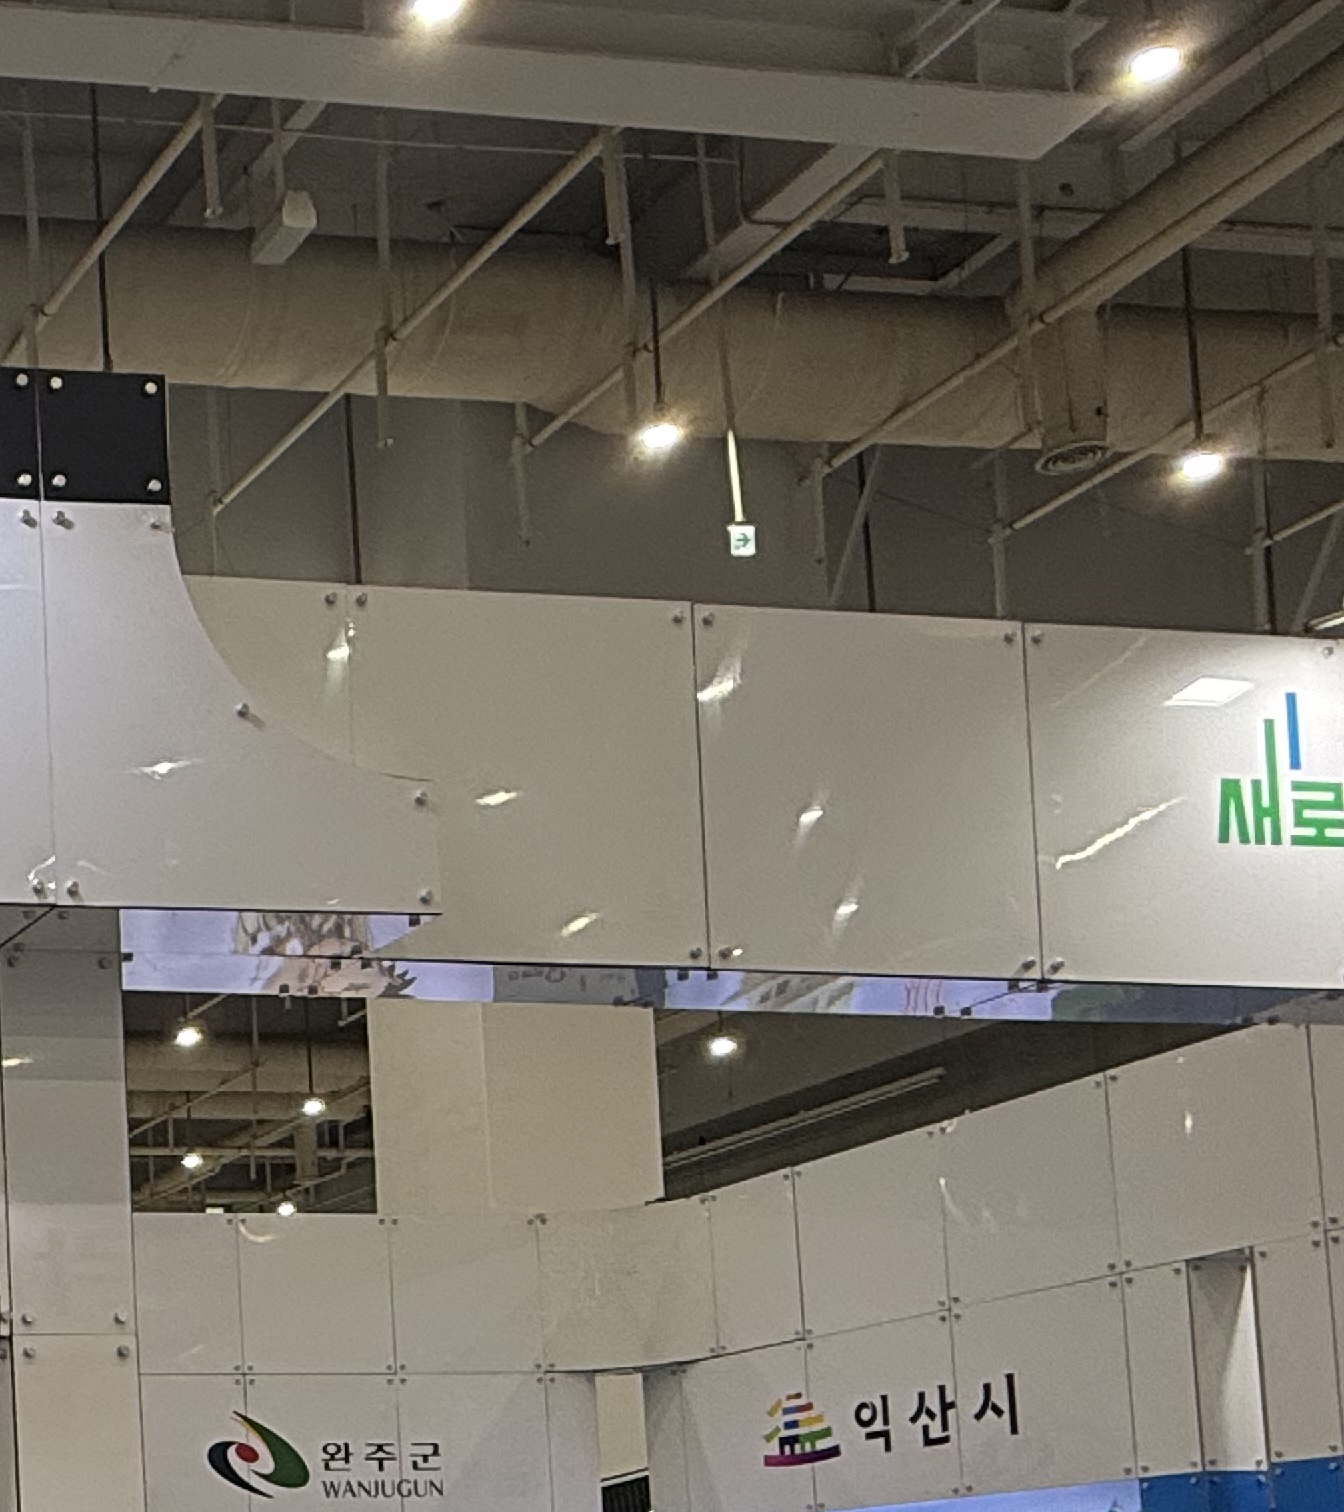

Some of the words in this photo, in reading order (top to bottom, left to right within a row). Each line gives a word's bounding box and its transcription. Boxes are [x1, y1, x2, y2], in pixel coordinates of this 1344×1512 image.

[854, 1373, 1020, 1453] 익산시
[321, 1441, 443, 1471] 완주군
[322, 1479, 444, 1498] WANJUGUN
